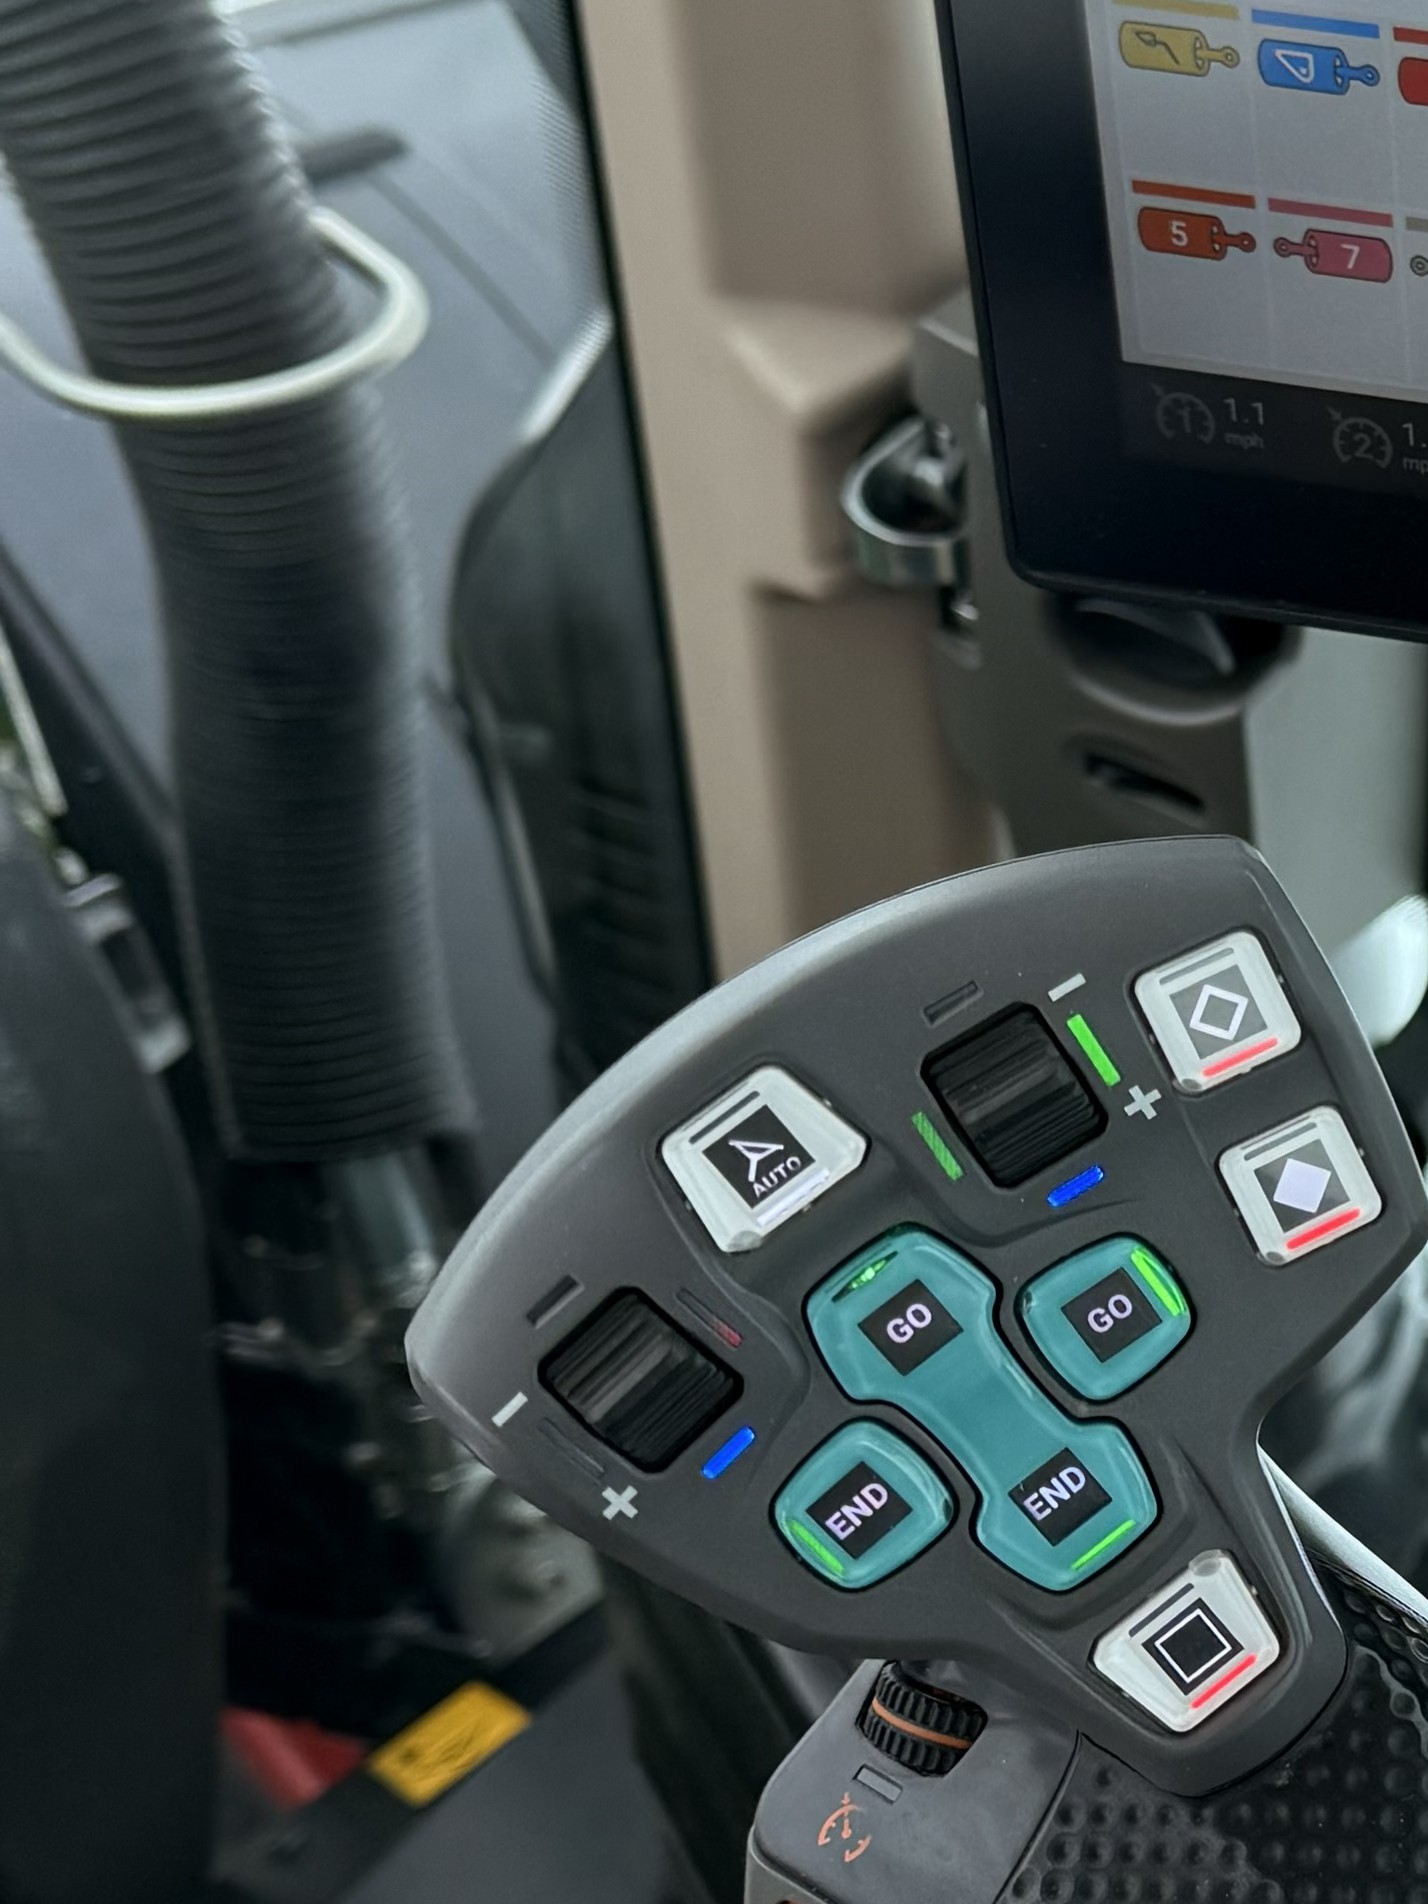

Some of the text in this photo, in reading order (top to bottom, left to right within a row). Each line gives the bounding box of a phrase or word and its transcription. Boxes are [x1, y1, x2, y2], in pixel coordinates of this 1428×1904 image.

[1170, 220, 1188, 248] 5
[1339, 244, 1361, 270] 7
[1224, 398, 1264, 426] 1.1
[751, 1155, 803, 1198] AUTO
[885, 1302, 933, 1344] GO
[1086, 1294, 1133, 1334] GO
[825, 1482, 889, 1541] END
[1023, 1466, 1087, 1522] END
